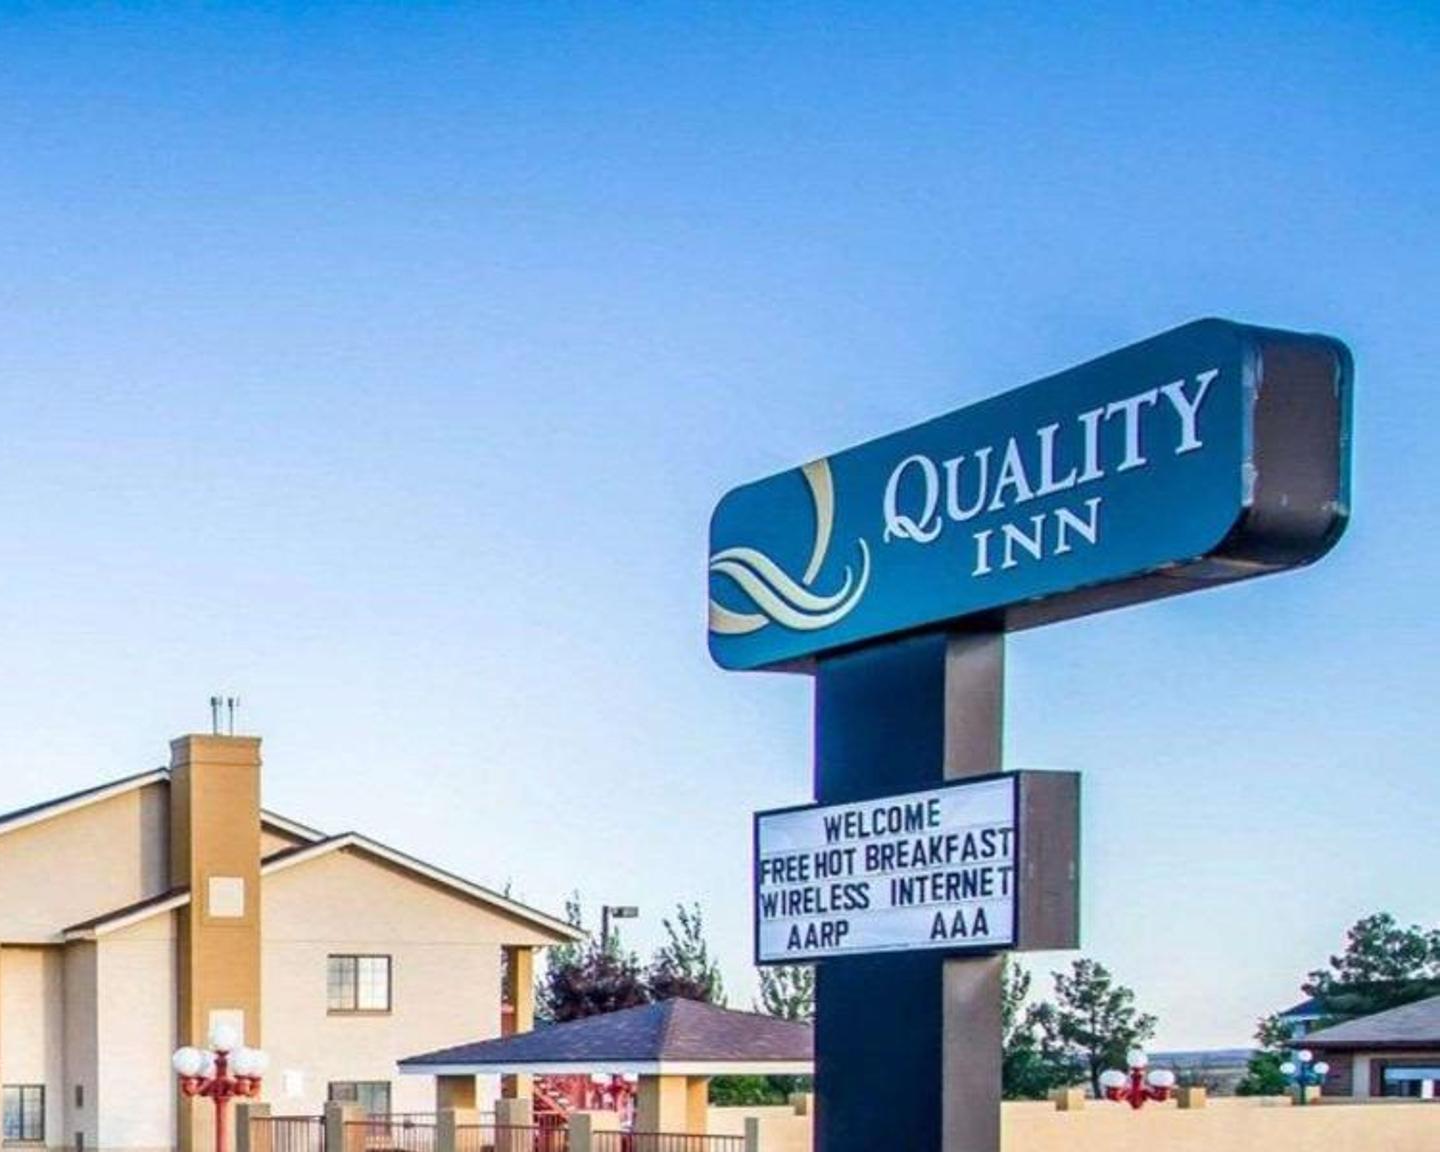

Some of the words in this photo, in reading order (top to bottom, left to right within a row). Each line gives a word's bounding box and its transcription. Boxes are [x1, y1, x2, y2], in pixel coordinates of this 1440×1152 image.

[883, 367, 1220, 543] QUALITY
[971, 498, 1102, 577] INN
[824, 799, 940, 843] WELCOME
[761, 853, 809, 885] FREE
[814, 847, 857, 879] HOT
[865, 827, 1014, 872] BREAKFAST
[761, 882, 870, 918] WIRELESS
[891, 865, 1013, 906] INTERNET
[787, 919, 849, 950] AARP
[930, 907, 989, 940] AAA
